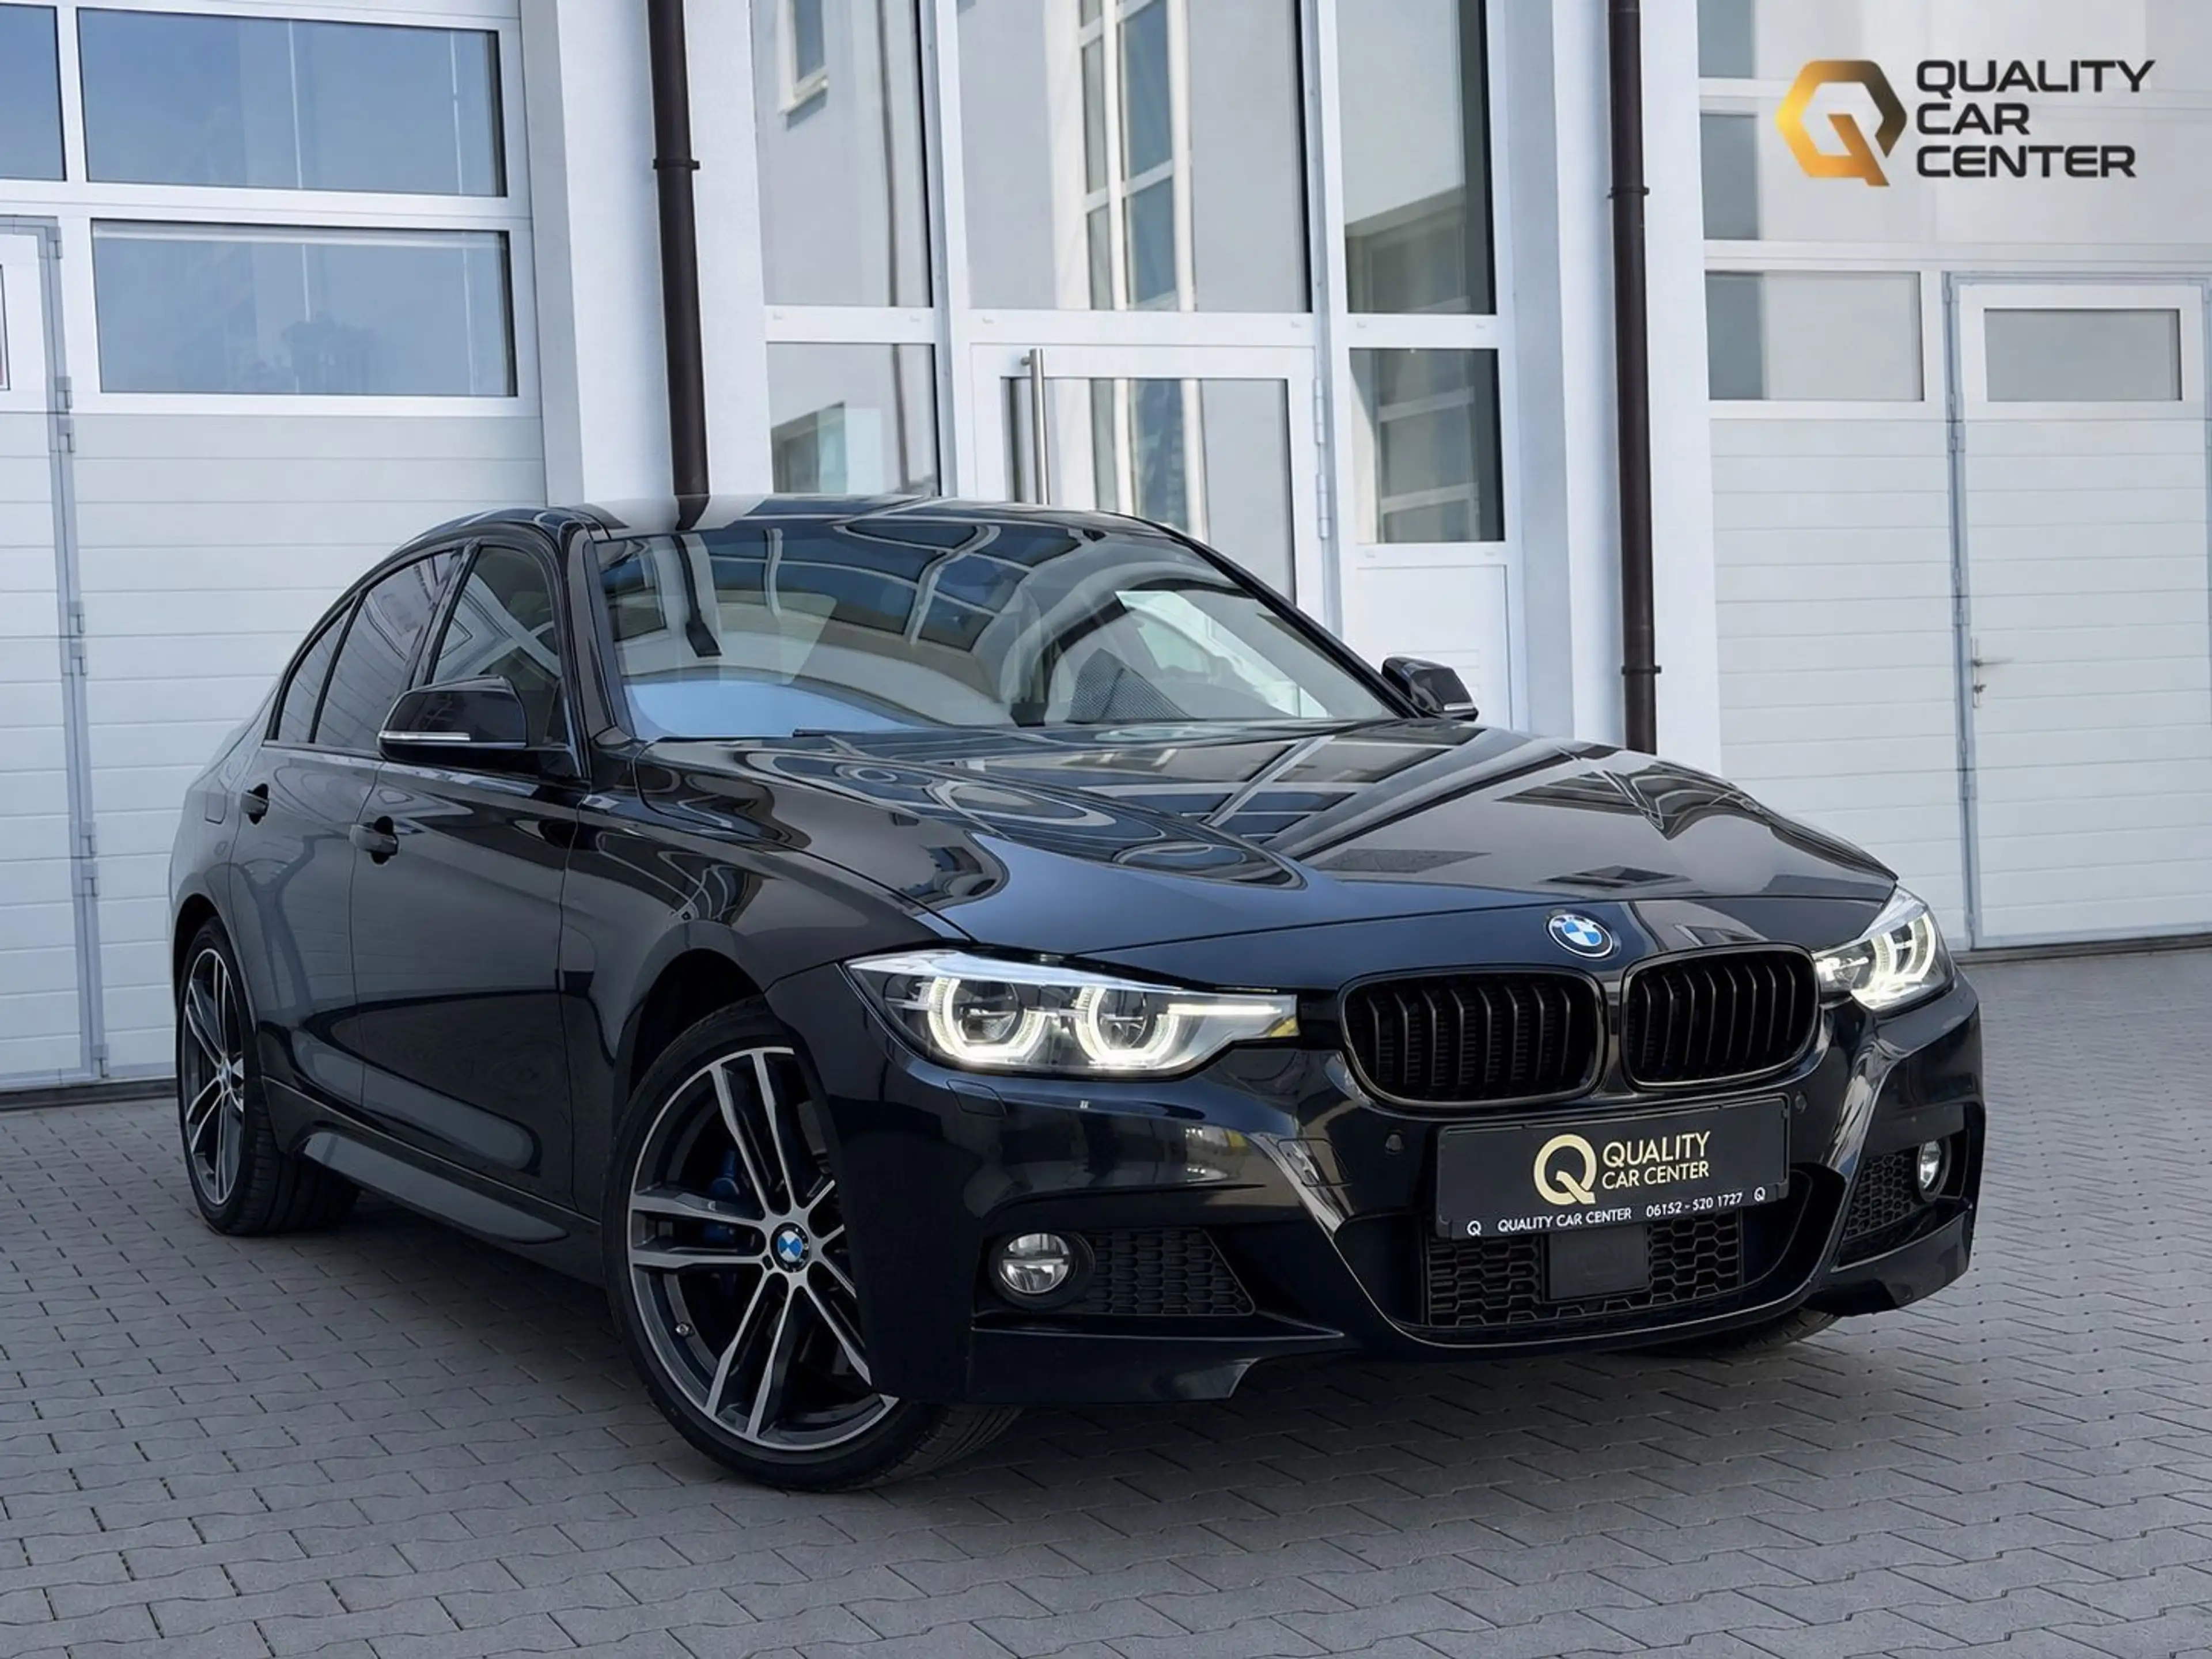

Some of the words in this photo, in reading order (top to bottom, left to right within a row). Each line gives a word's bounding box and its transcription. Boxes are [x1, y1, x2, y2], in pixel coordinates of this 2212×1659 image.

[1603, 1131, 1711, 1168] QUALITY
[1602, 1169, 1641, 1190] CAR
[1643, 1161, 1710, 1185] CENTER
[1467, 1220, 1482, 1236] Q
[1498, 1215, 1553, 1233] QUALITY
[1556, 1213, 1582, 1226] CAR
[1585, 1207, 1632, 1224] CENTER
[1646, 1201, 1683, 1218] 06152
[1692, 1196, 1713, 1211] 520
[1717, 1192, 1743, 1208] 1727
[1753, 1186, 1766, 1202] Q
